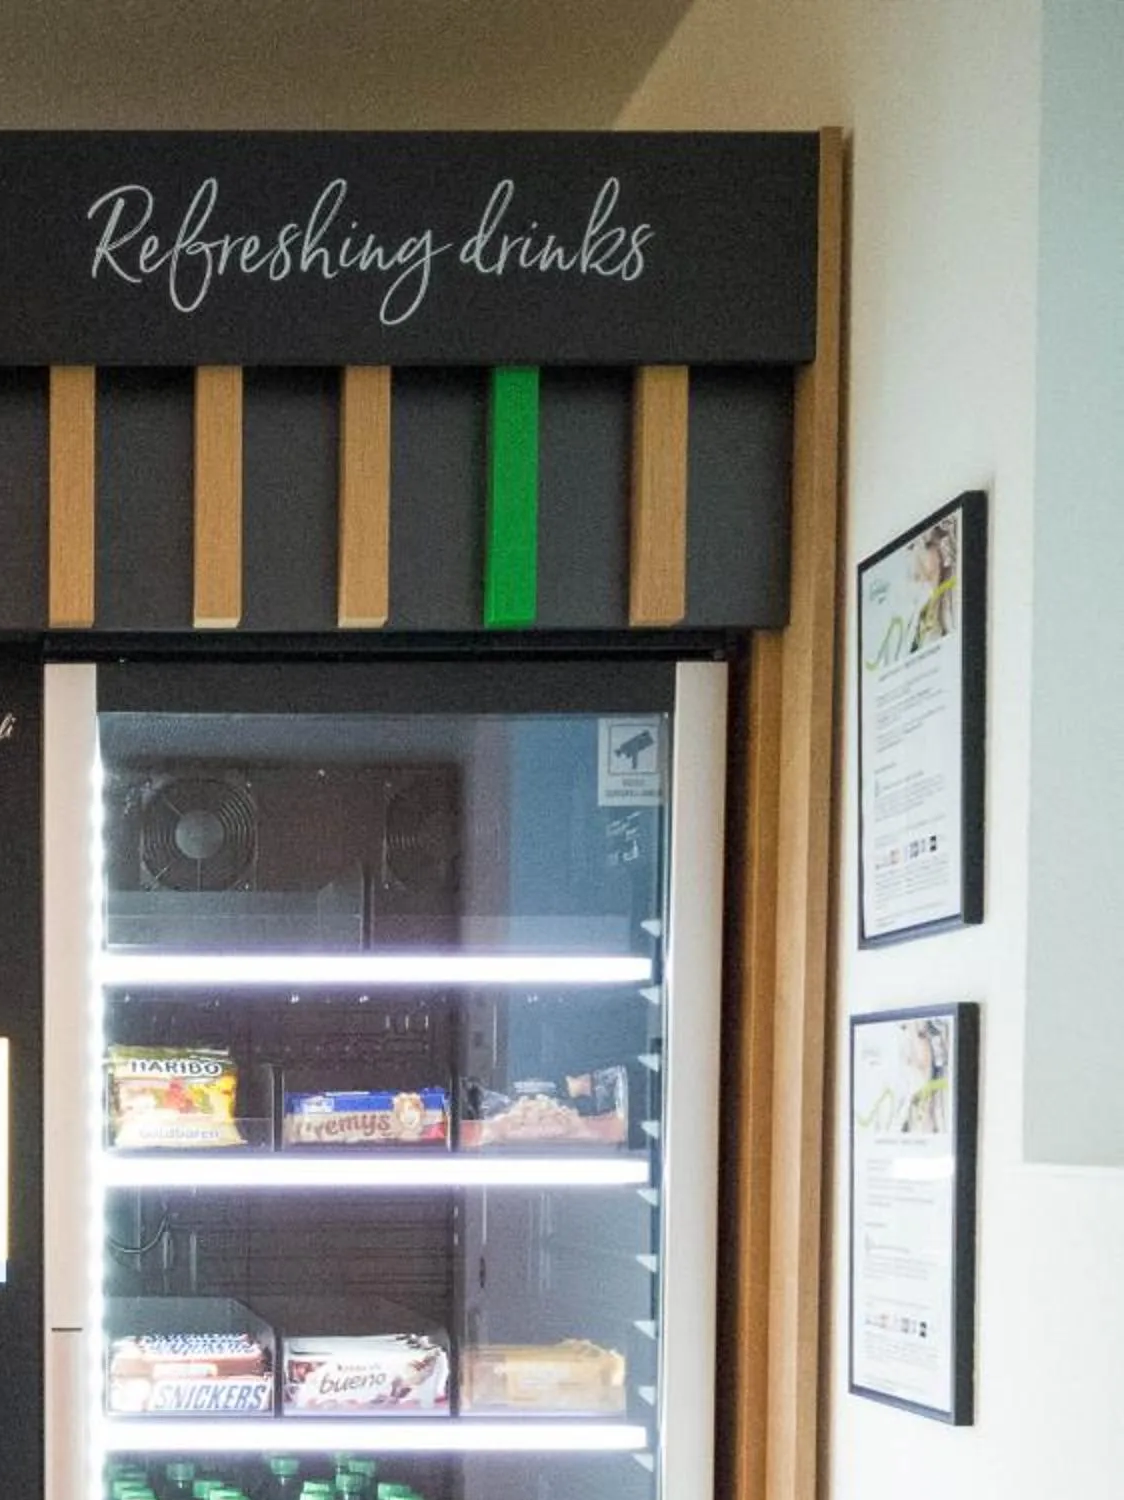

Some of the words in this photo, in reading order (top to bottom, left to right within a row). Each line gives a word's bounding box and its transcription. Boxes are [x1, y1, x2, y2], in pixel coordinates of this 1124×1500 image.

[86, 177, 453, 325] Refreshing
[459, 177, 655, 281] drinks
[130, 1059, 223, 1076] HARIBO
[319, 1372, 389, 1395] bueno
[155, 1384, 267, 1410] SNICKERS
